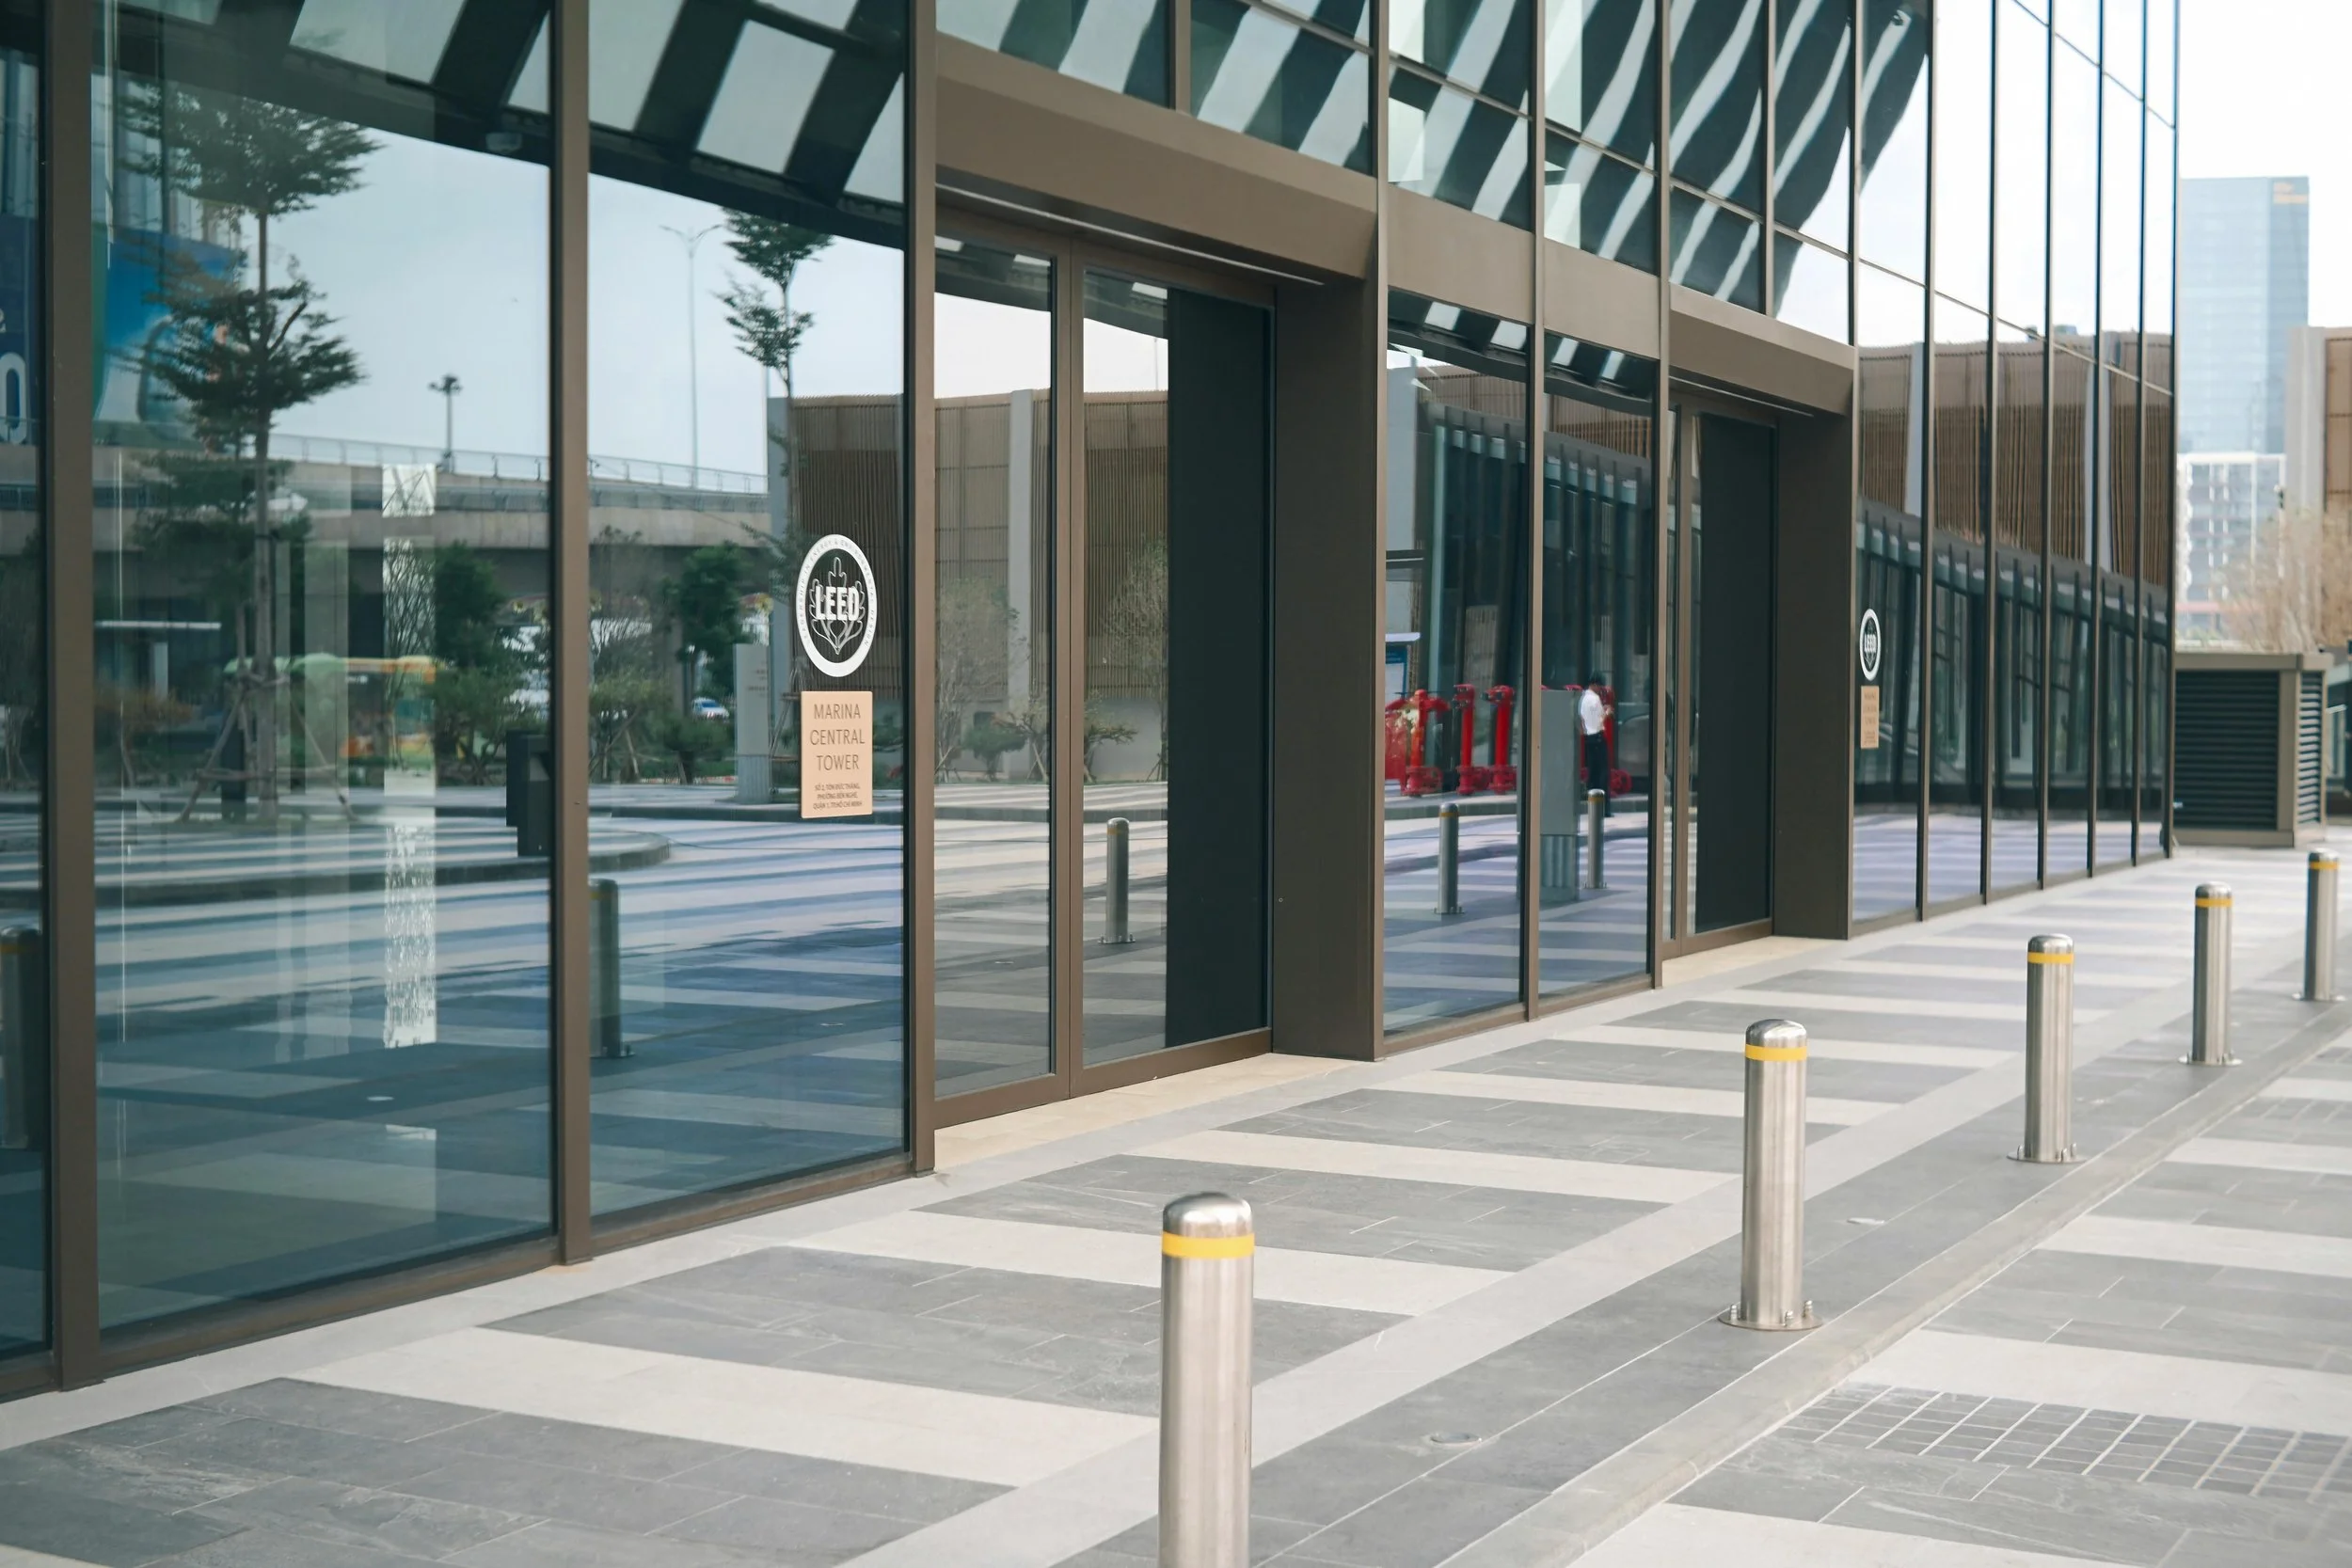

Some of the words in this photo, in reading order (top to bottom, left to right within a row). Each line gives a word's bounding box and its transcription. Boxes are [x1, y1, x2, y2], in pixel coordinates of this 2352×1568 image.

[815, 586, 860, 621] LEED
[814, 704, 861, 720] MARINA
[810, 729, 866, 745] CENTRAL
[816, 754, 860, 771] TOWER
